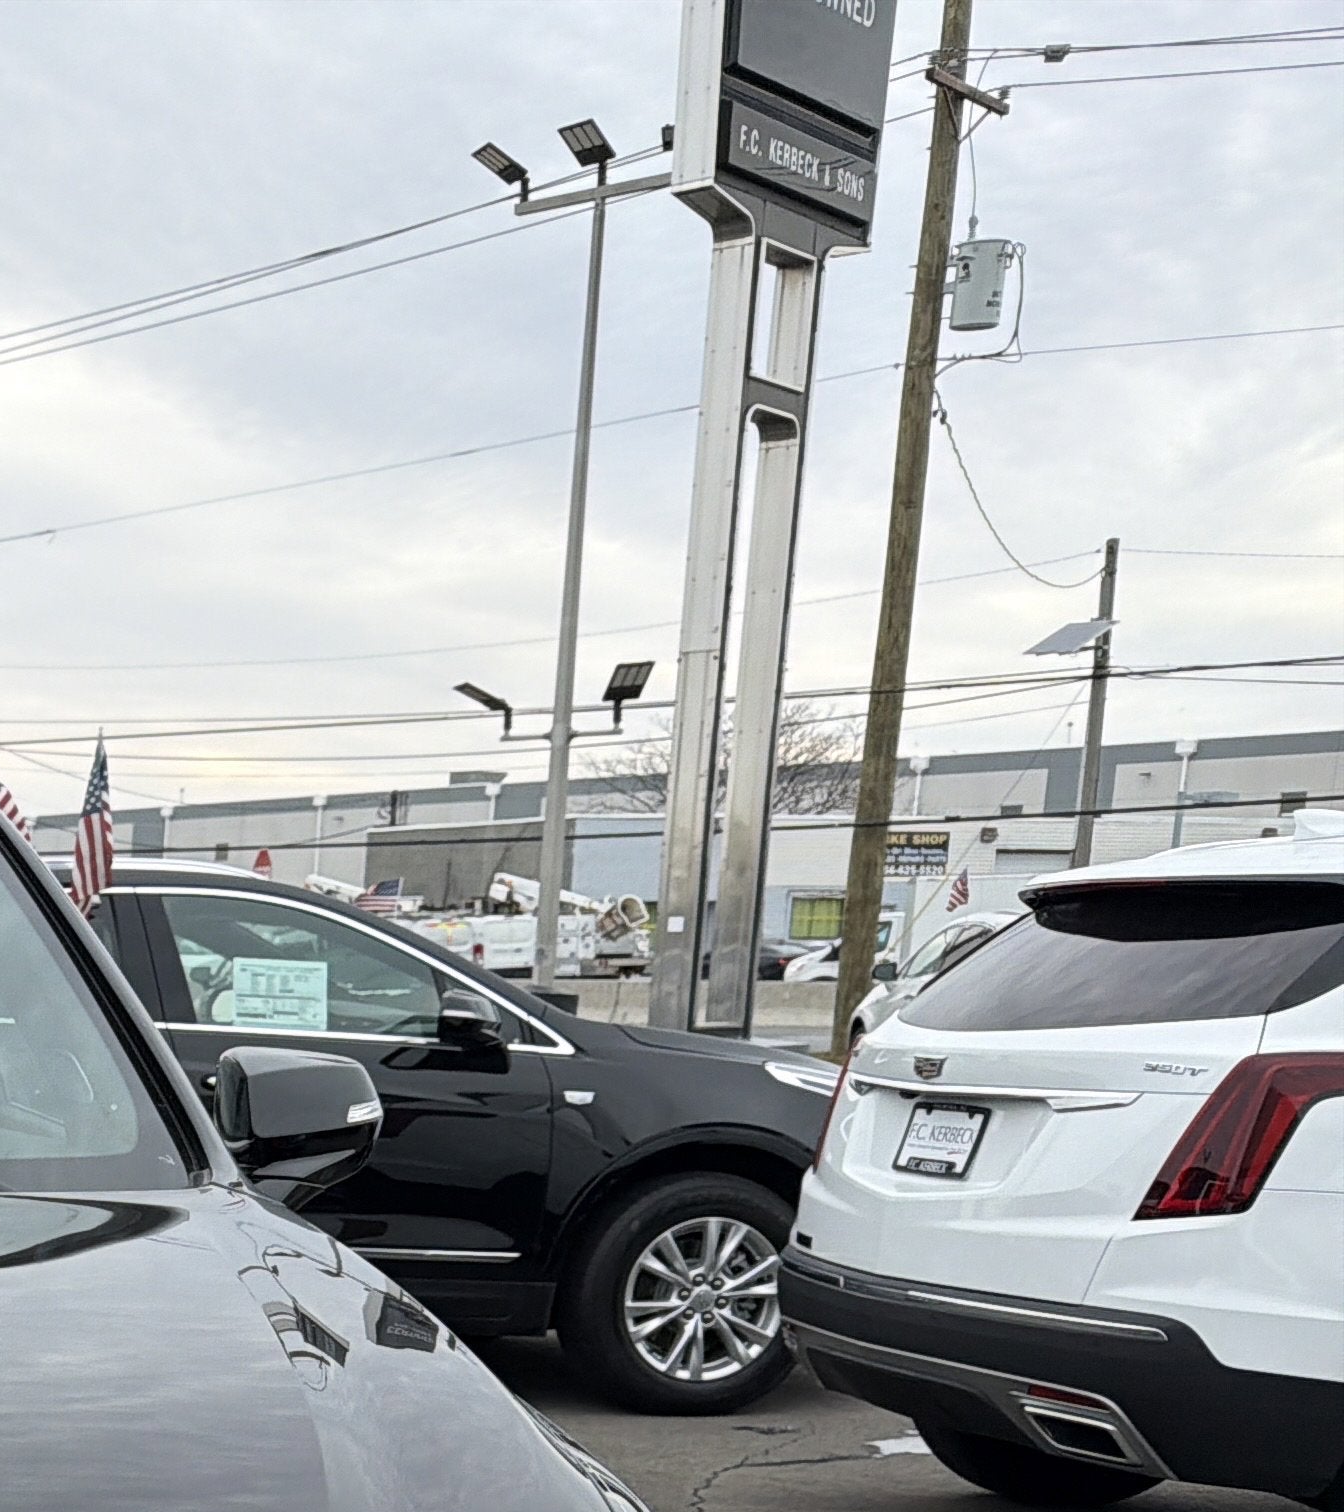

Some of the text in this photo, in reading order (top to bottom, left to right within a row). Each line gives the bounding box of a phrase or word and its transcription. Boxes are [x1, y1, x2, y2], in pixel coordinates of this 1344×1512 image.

[739, 124, 865, 202] F.C. KERBECK & SONS
[912, 834, 948, 846] SHOP
